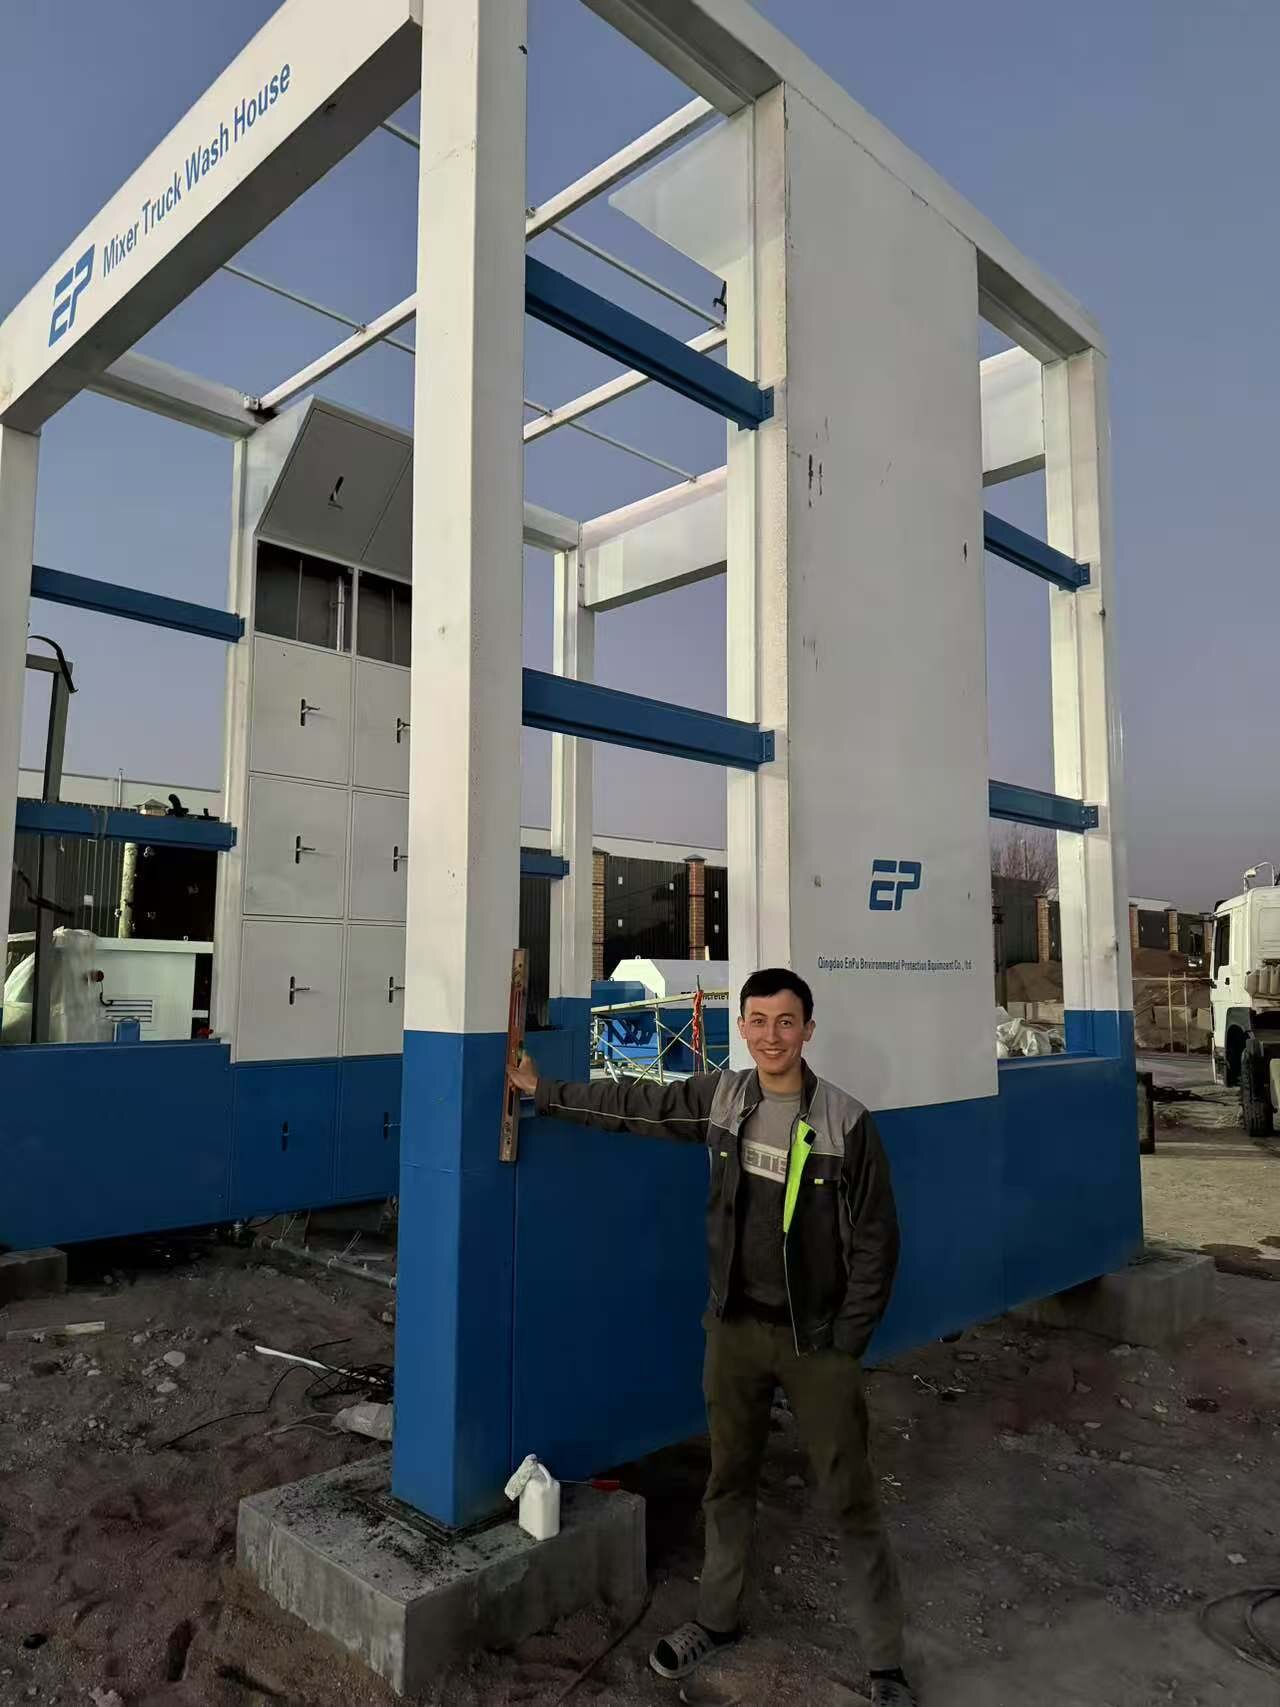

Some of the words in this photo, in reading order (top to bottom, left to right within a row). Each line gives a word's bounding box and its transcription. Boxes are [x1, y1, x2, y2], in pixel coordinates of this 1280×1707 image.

[103, 221, 140, 278] Mixer
[142, 171, 182, 235] Truck
[185, 121, 229, 192] Wash
[234, 63, 291, 143] House
[817, 956, 844, 972] Qingdao
